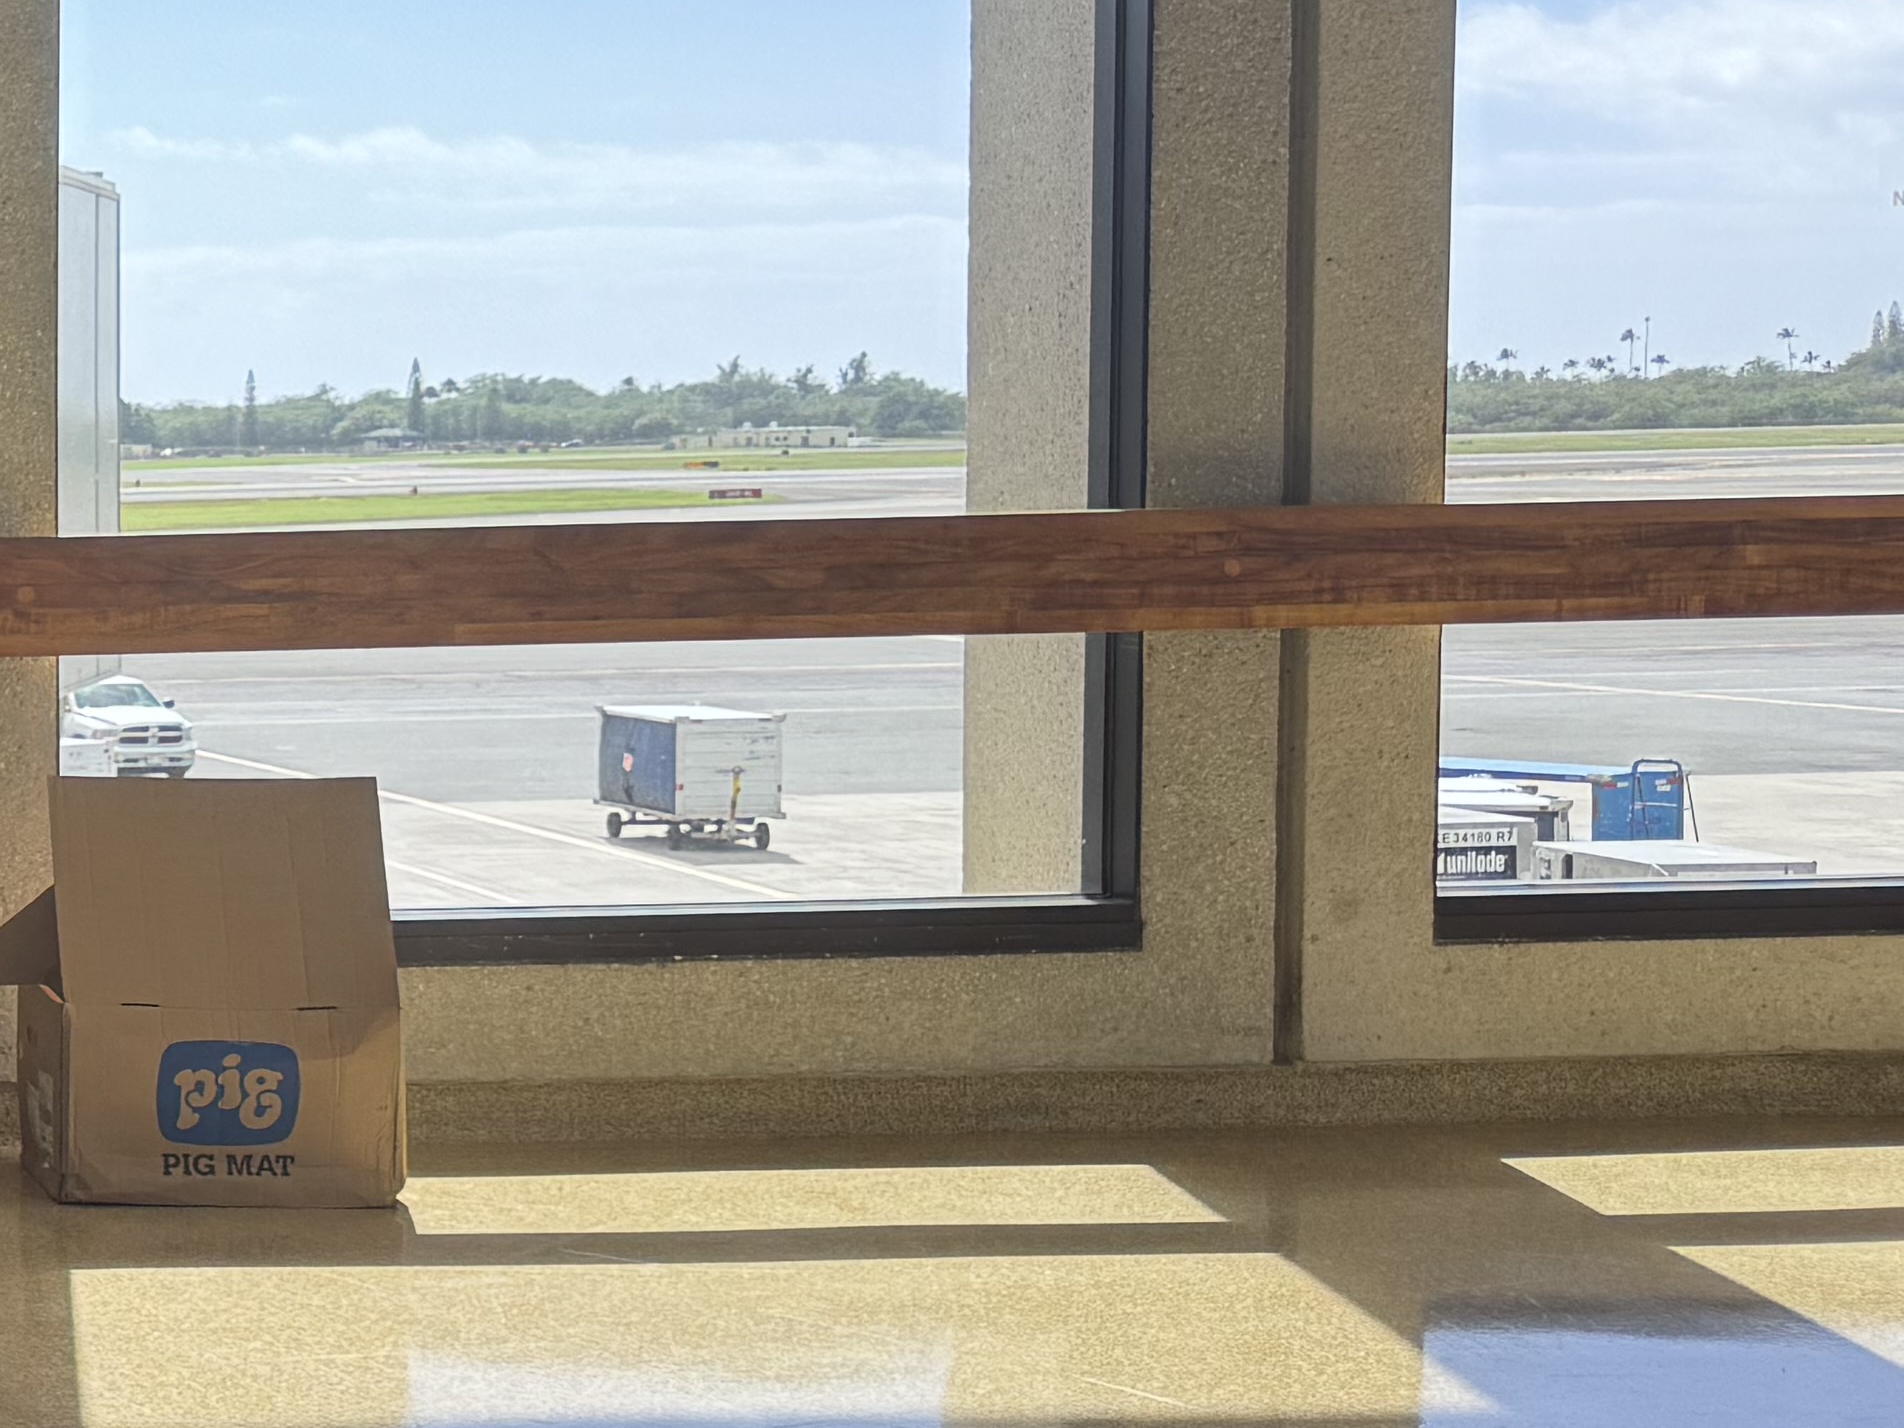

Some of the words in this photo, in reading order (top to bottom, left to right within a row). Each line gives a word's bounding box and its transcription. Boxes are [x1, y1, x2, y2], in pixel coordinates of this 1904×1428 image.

[1496, 829, 1513, 842] R7
[1446, 850, 1506, 875] unilode
[173, 1053, 284, 1131] pig
[161, 1153, 216, 1176] PIG
[225, 1153, 296, 1176] MAT
